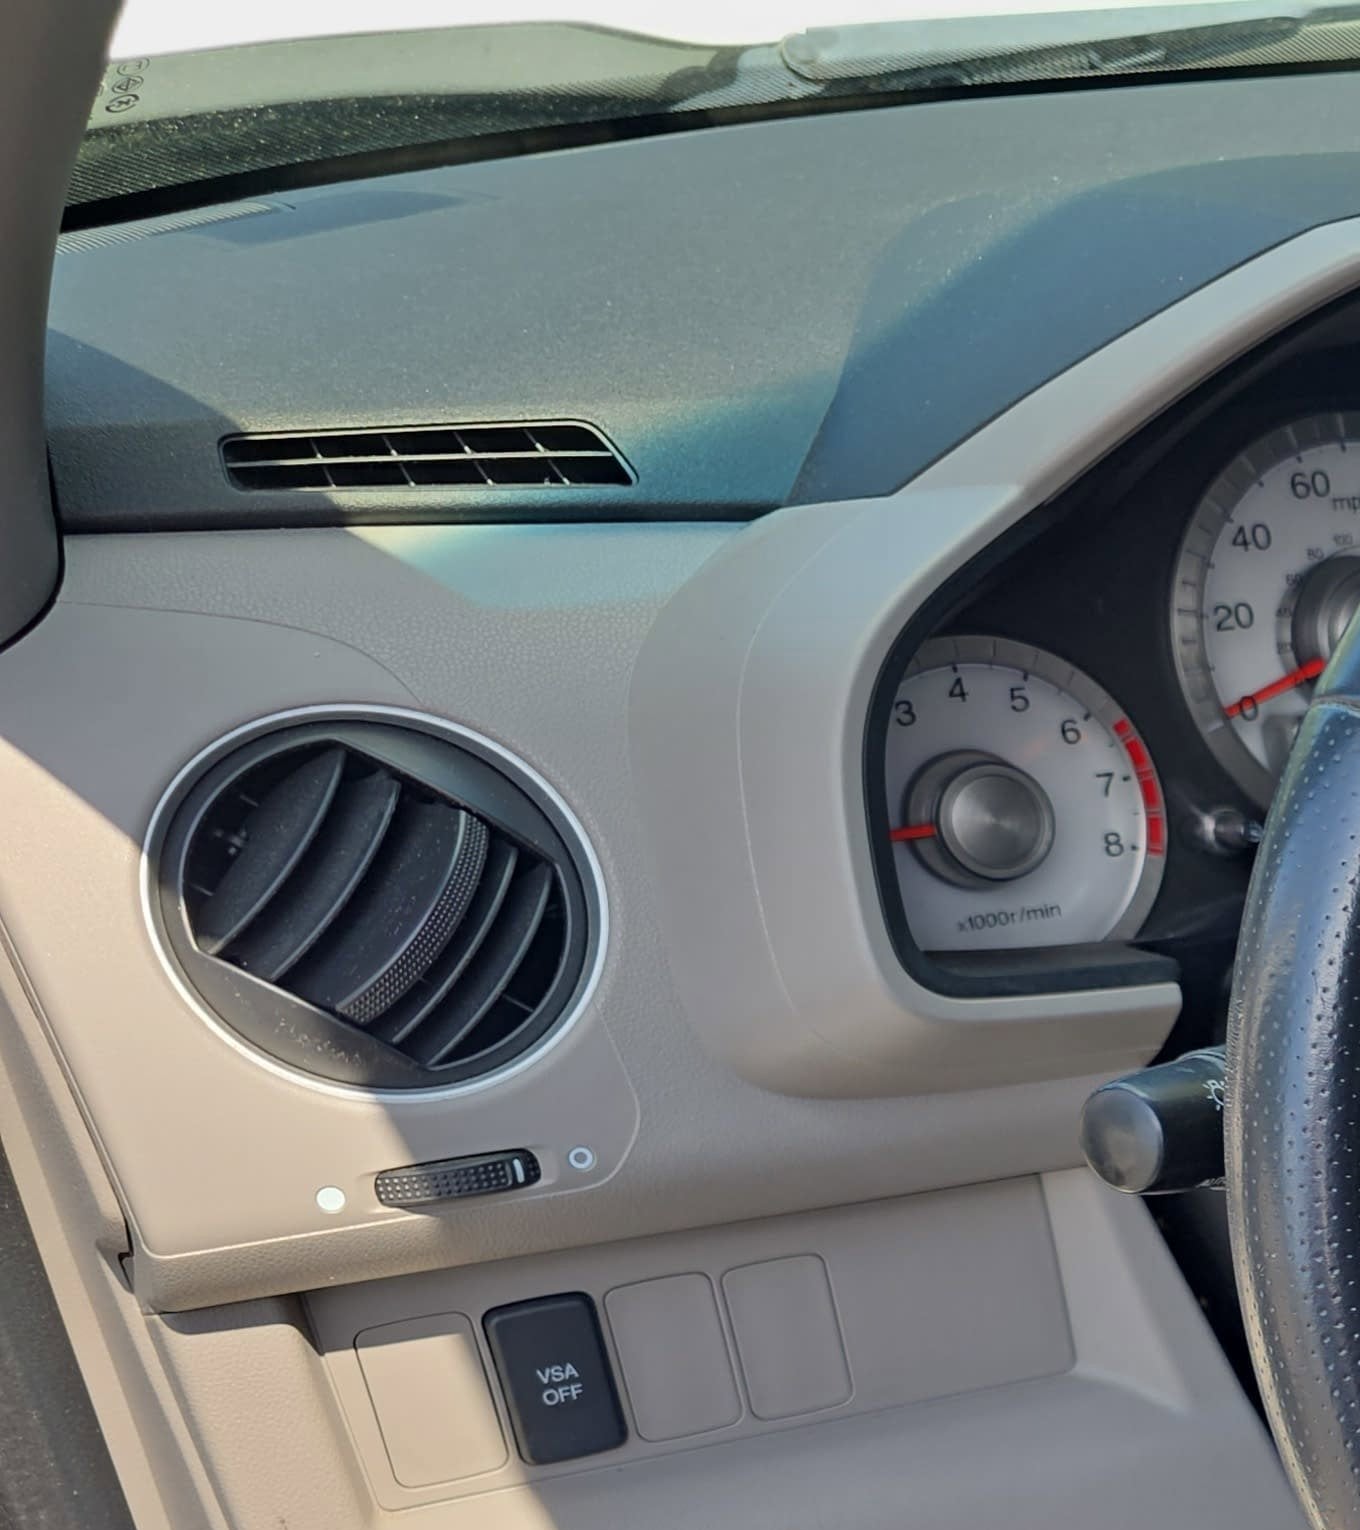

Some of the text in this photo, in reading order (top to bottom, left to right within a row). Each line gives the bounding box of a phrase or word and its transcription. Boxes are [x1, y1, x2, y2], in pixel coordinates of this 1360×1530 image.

[1290, 470, 1330, 500] 60
[1232, 523, 1272, 552] 40
[1213, 602, 1254, 632] 20
[949, 677, 968, 703] 4
[1010, 687, 1030, 712] 5
[895, 700, 916, 726] 3
[1240, 696, 1259, 721] 0
[1061, 719, 1082, 744] 6
[1095, 772, 1114, 797] 7
[1104, 833, 1124, 857] 8
[536, 1362, 579, 1384] VSA
[542, 1383, 583, 1405] OFF
